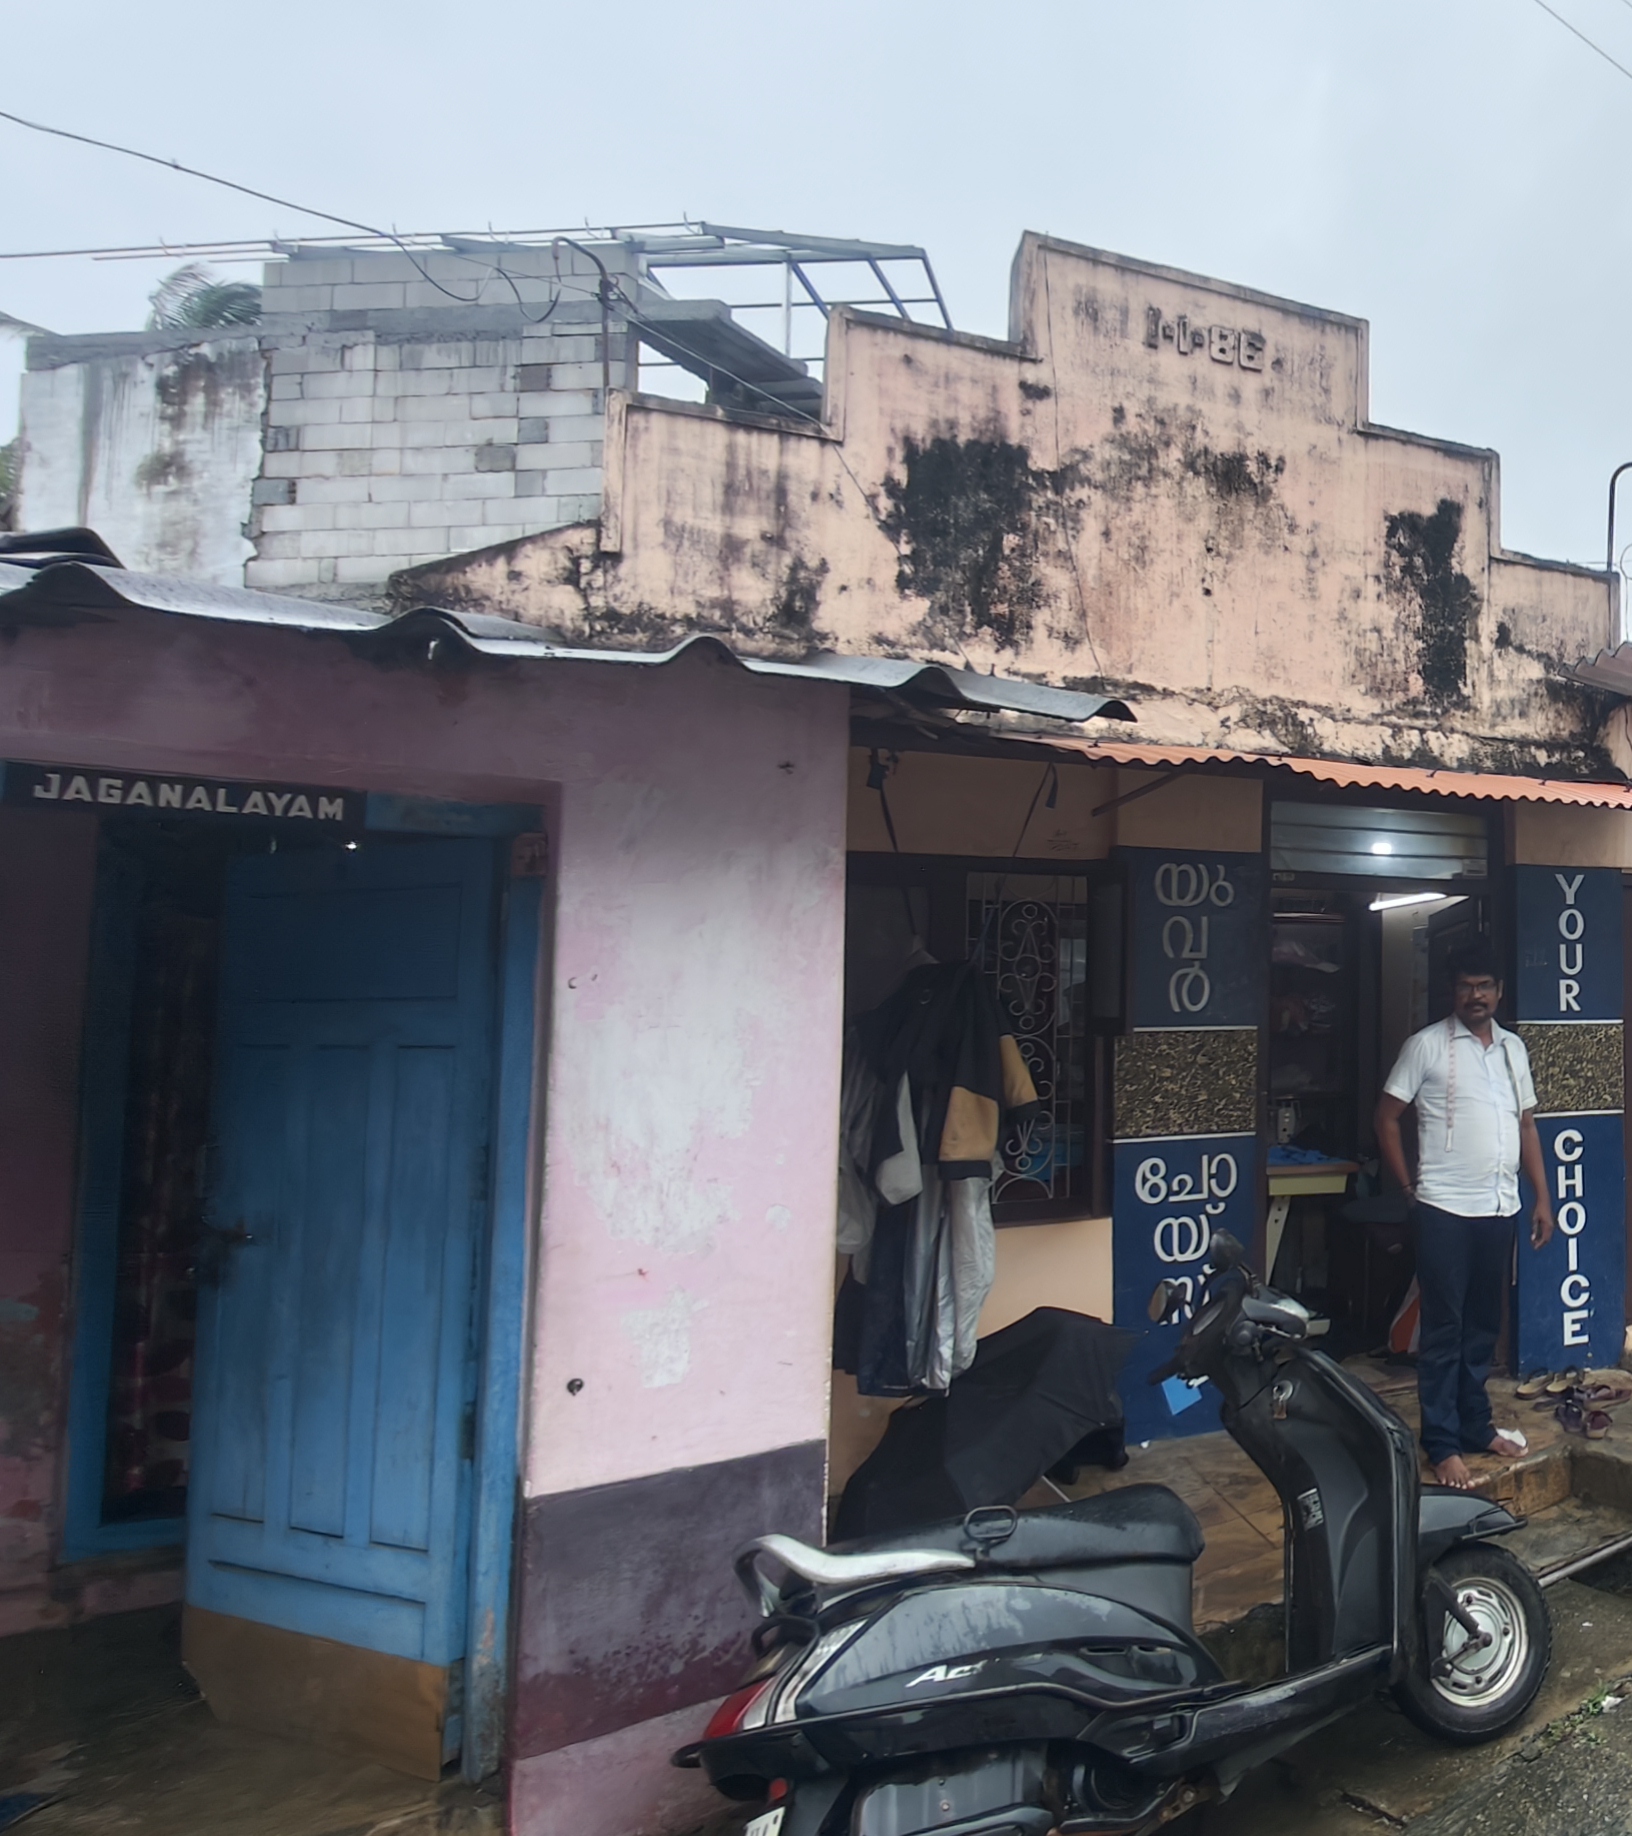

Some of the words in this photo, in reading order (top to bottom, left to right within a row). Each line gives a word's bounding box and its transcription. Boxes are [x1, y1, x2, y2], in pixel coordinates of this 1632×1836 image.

[33, 773, 345, 822] JAGANALAYAM
[1554, 873, 1585, 1012] YOUR
[1553, 1129, 1590, 1347] CHOICE
